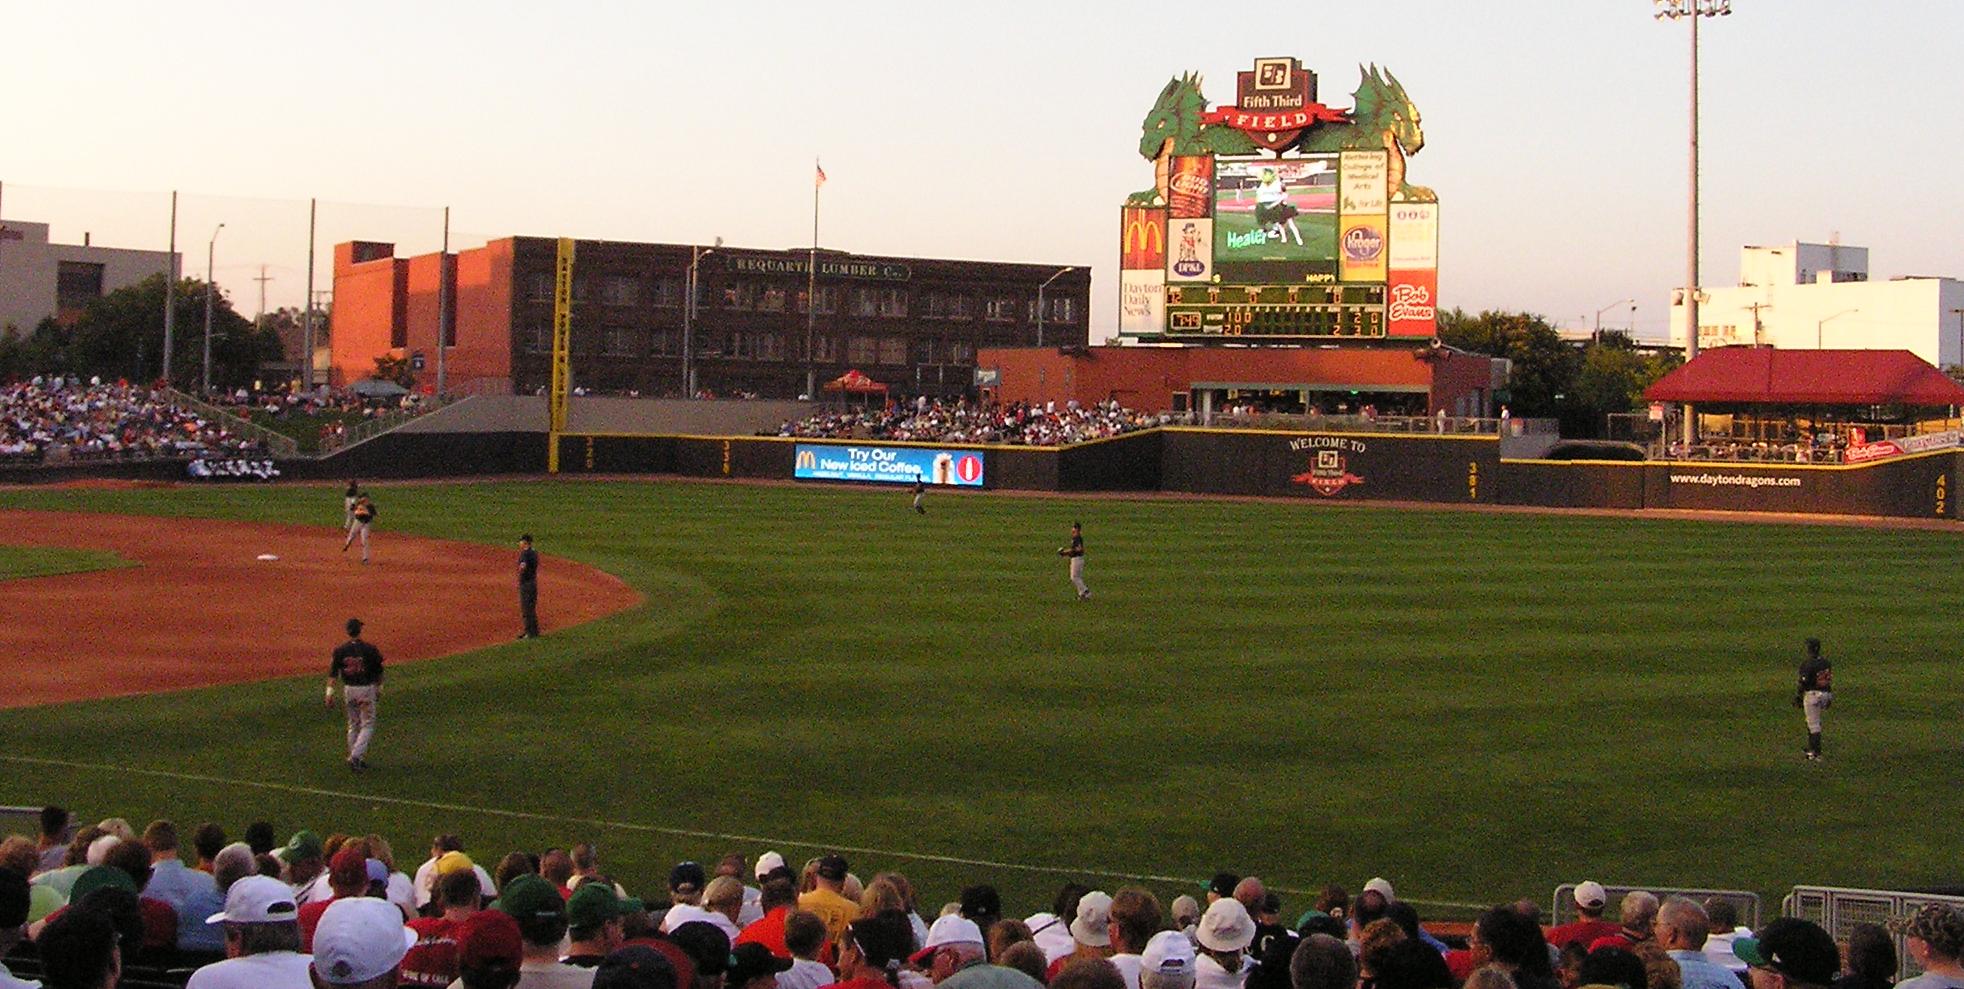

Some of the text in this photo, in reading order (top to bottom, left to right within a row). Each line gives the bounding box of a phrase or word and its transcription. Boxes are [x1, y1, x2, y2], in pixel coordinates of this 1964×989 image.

[1243, 94, 1303, 108] Fifth Third
[1237, 113, 1307, 128] FIELD
[1227, 229, 1267, 248] Heater
[1347, 230, 1381, 257] Kroger
[822, 262, 877, 276] LUMBER
[1124, 283, 1162, 295] Dayton
[1393, 285, 1429, 303] Bob
[1124, 294, 1150, 308] Daily
[1124, 305, 1151, 316] News
[1390, 301, 1434, 320] Evans
[1333, 325, 1340, 336] 2
[1289, 437, 1366, 453] WELCOME TO
[848, 448, 897, 462] Try Our
[820, 459, 924, 475] New Iced Coffee.
[1670, 474, 1800, 488] www.daytondragons.com
[1936, 474, 1945, 514] 402
